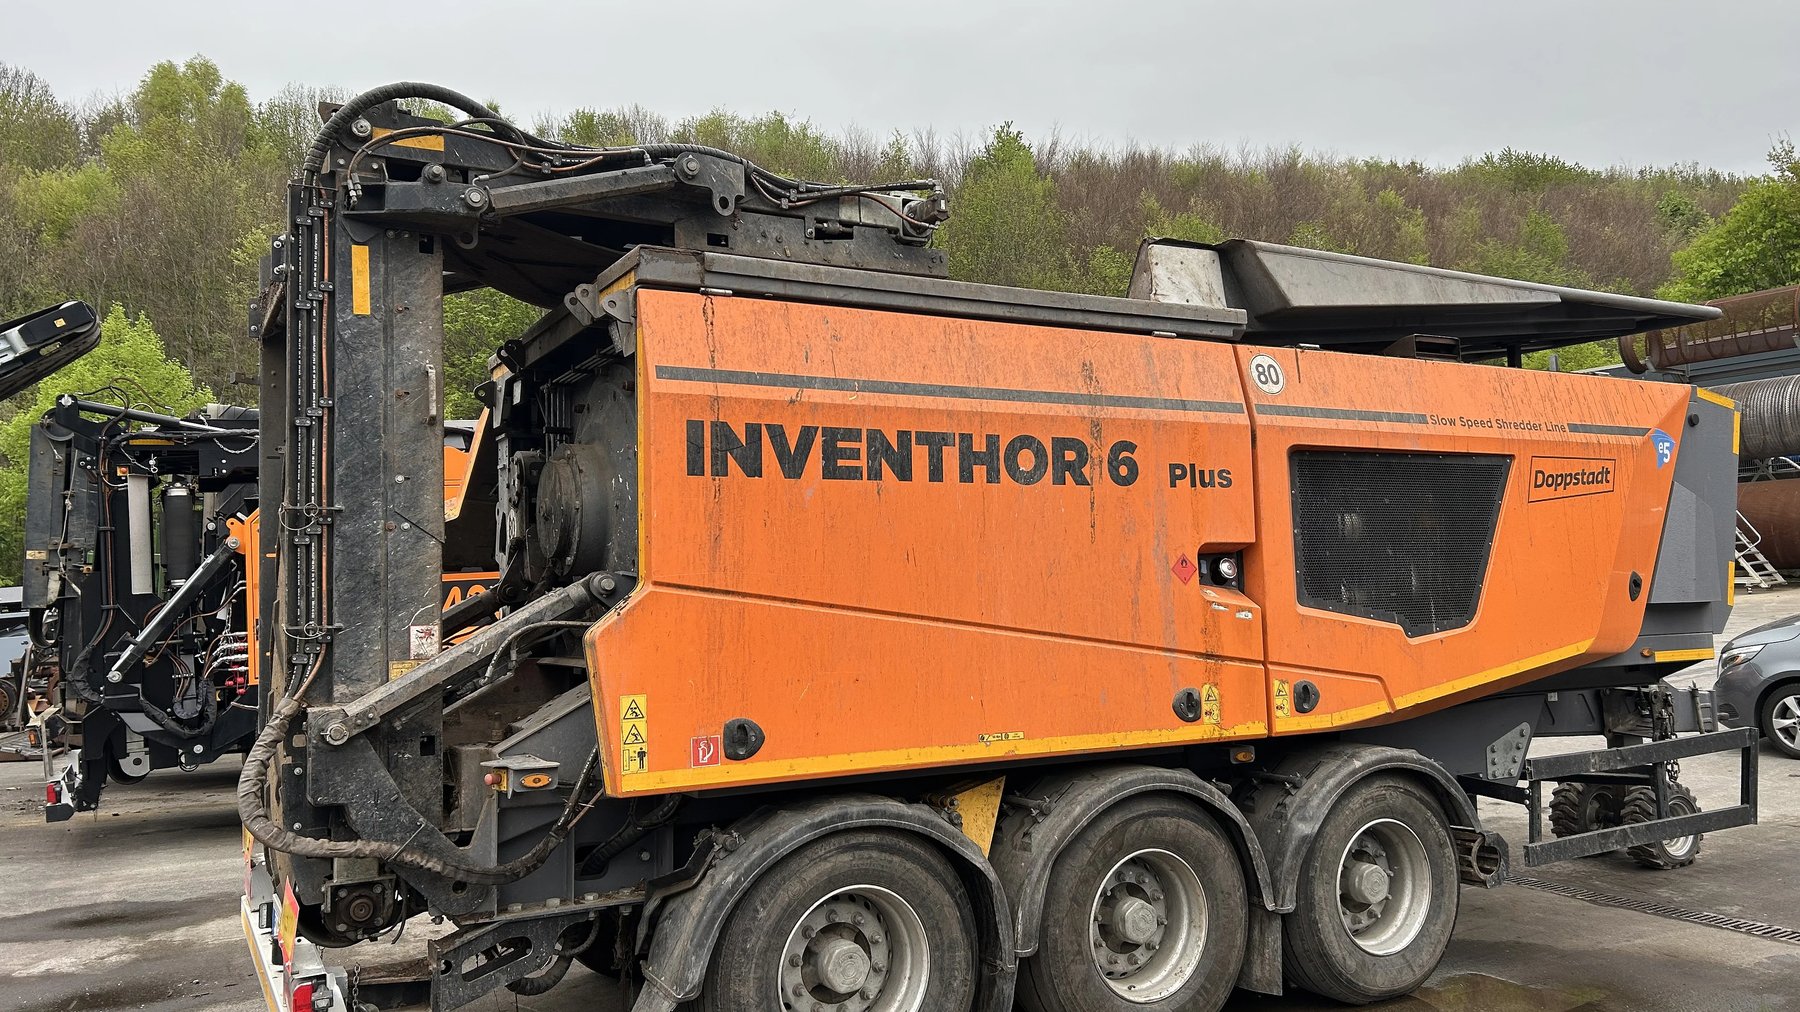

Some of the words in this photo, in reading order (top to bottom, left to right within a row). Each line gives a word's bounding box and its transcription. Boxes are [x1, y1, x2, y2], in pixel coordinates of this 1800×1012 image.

[1255, 363, 1280, 385] 80
[1429, 414, 1456, 426] Slow
[1459, 416, 1493, 429] Speed
[1495, 418, 1542, 431] Shredder
[1544, 421, 1567, 432] Line
[686, 419, 1090, 486] INVENTHOR
[1106, 440, 1139, 486] 6
[1169, 462, 1232, 488] Plus
[1658, 441, 1671, 463] e5
[1534, 466, 1610, 491] Doppstadt
